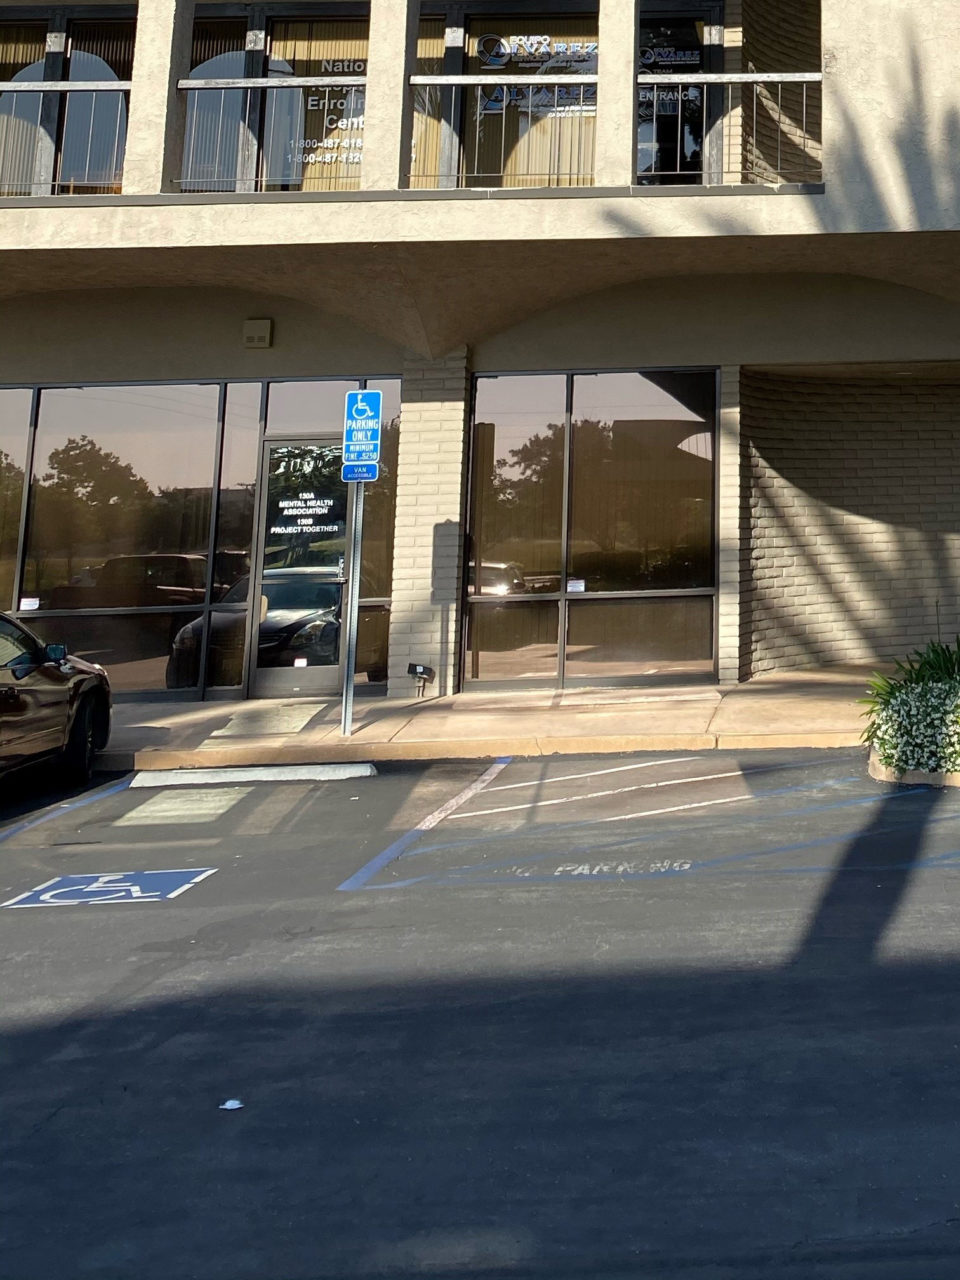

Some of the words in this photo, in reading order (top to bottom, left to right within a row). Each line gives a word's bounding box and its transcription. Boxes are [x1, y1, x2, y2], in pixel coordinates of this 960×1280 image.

[510, 36, 550, 44] EQUIPO
[489, 41, 597, 55] ALVAREZ
[321, 60, 367, 73] Natio
[491, 86, 597, 98] ALVAREZ
[639, 91, 696, 101] ENTRANCE
[346, 419, 379, 431] PARKING
[352, 430, 373, 442] ONLY
[349, 443, 374, 452] MINIMUM
[345, 452, 358, 461] FINE
[278, 500, 306, 508] MENTAL
[282, 507, 329, 516] ASSOCIATION
[270, 526, 301, 534] PROJECT
[302, 525, 339, 533] TOGETHER
[554, 859, 692, 876] PARKNG
